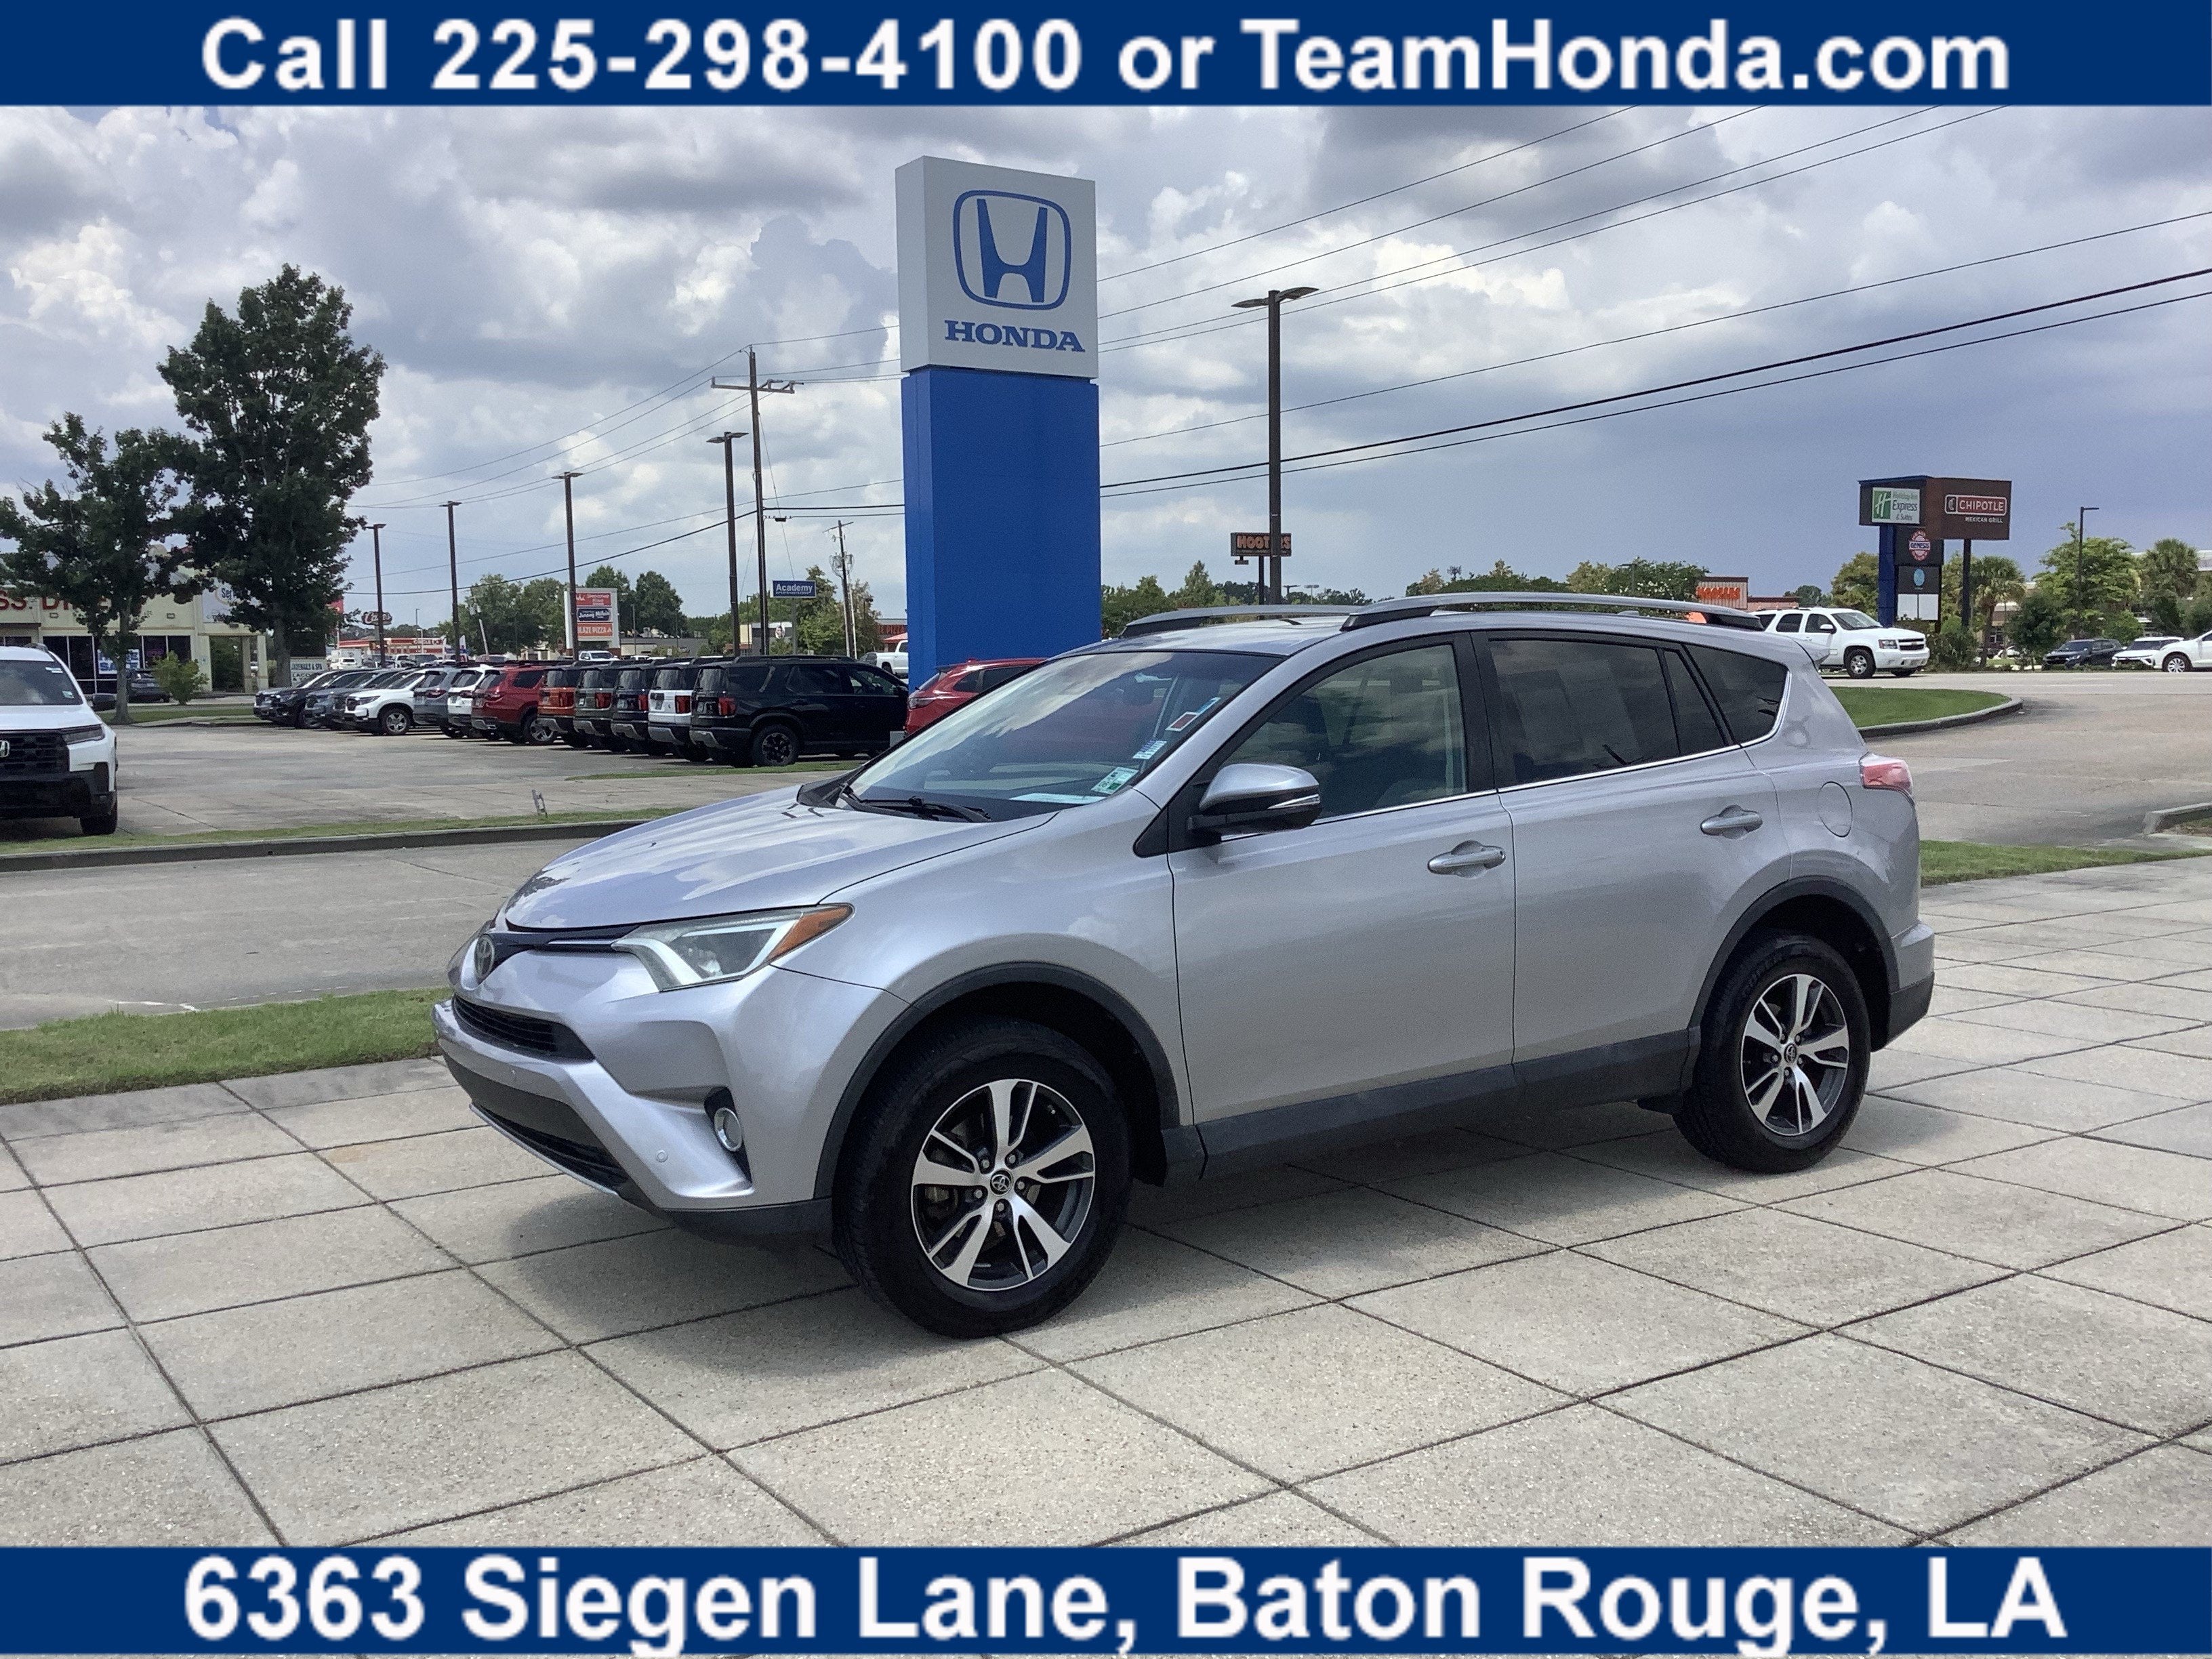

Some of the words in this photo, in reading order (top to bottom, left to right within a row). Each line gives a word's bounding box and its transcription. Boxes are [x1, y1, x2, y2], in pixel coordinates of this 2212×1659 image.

[944, 319, 1086, 352] HONDA
[1892, 499, 1918, 513] Express
[1959, 499, 2005, 512] CHIPOTLE
[775, 583, 813, 594] Academy
